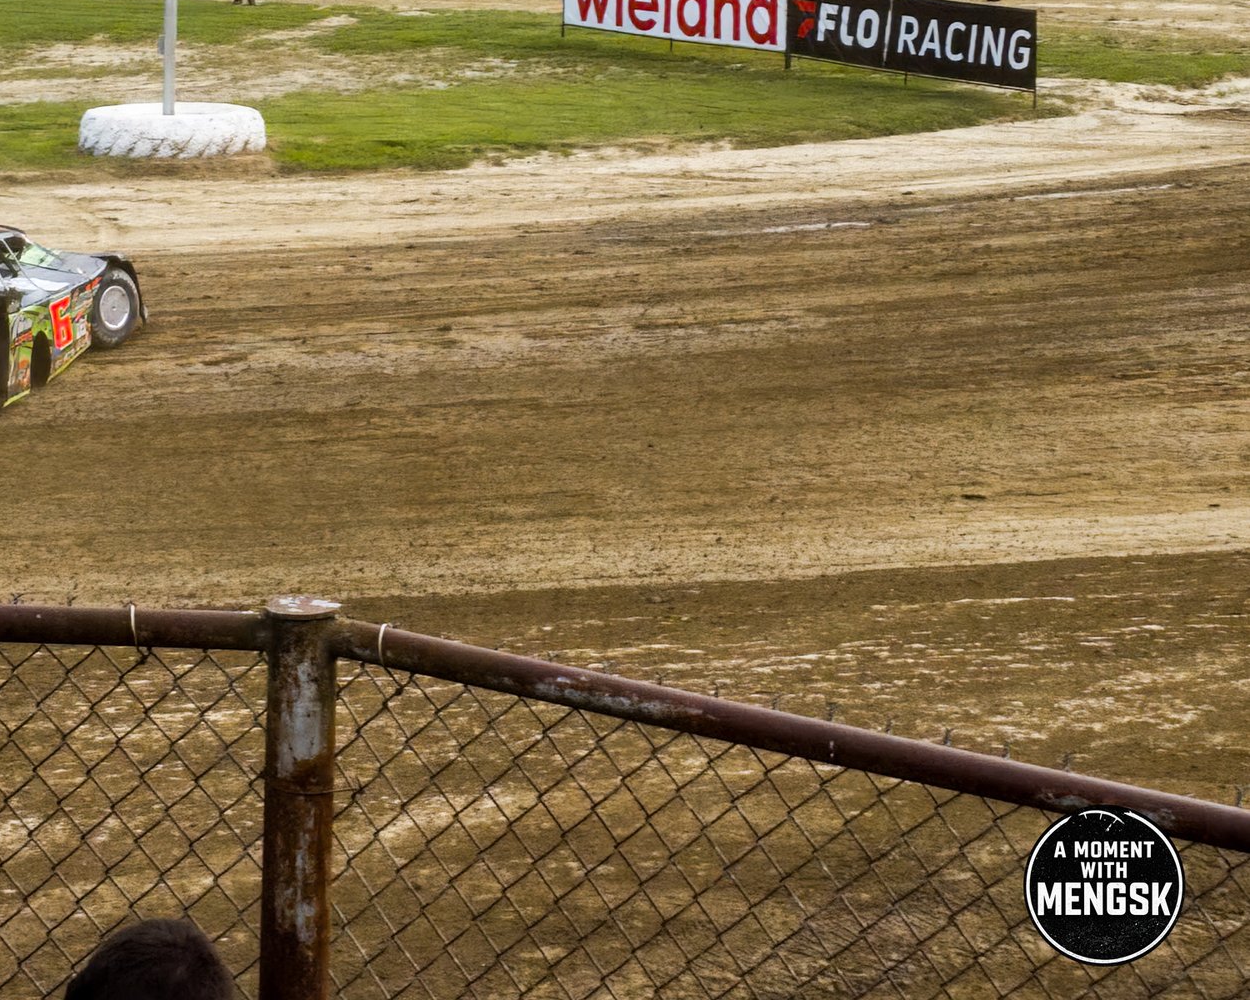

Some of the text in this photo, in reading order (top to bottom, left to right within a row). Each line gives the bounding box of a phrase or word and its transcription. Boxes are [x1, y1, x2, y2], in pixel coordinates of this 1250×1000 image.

[816, 3, 1032, 71] FLO RACING
[49, 296, 74, 350] 6
